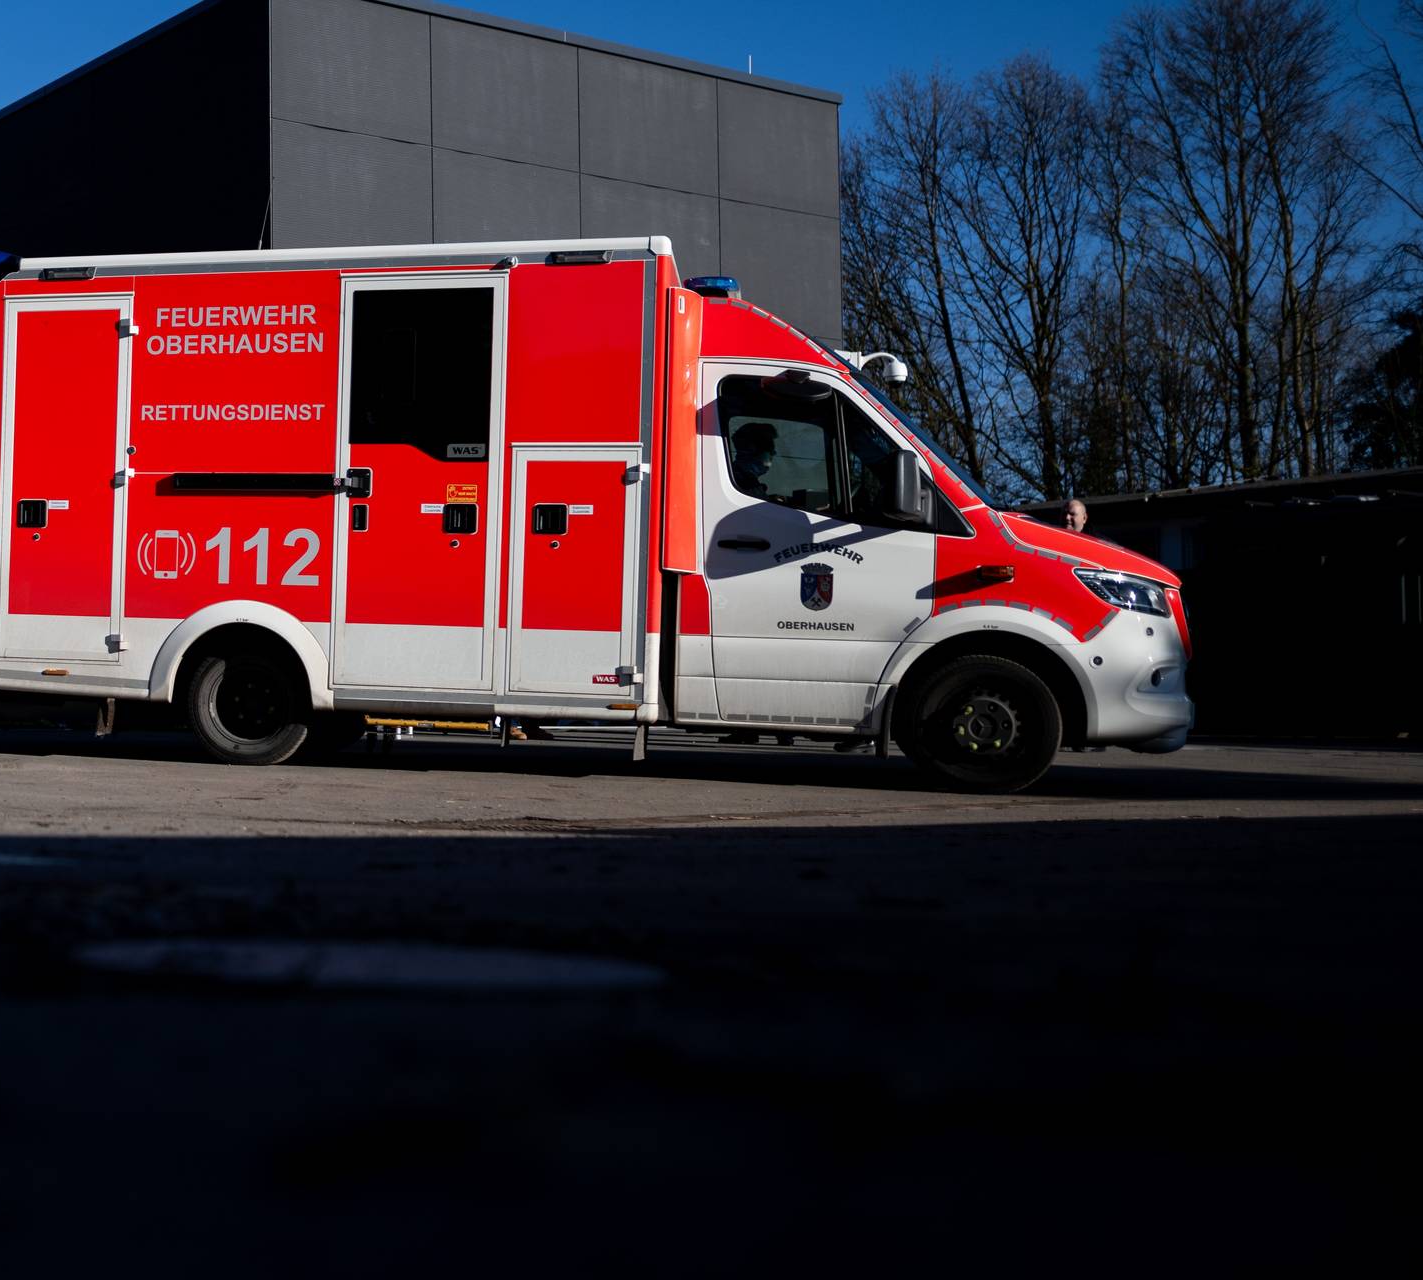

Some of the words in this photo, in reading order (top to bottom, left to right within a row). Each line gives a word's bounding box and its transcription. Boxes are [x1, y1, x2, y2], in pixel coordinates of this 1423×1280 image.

[156, 304, 317, 328] FEUERWEHR
[146, 332, 324, 355] OBERHAUSEN
[141, 404, 325, 421] RETTUNGSDIENST
[452, 446, 479, 455] WAS
[205, 527, 320, 586] 112
[773, 542, 864, 565] FEUERWEHR
[777, 620, 855, 631] OBERHAUSEN
